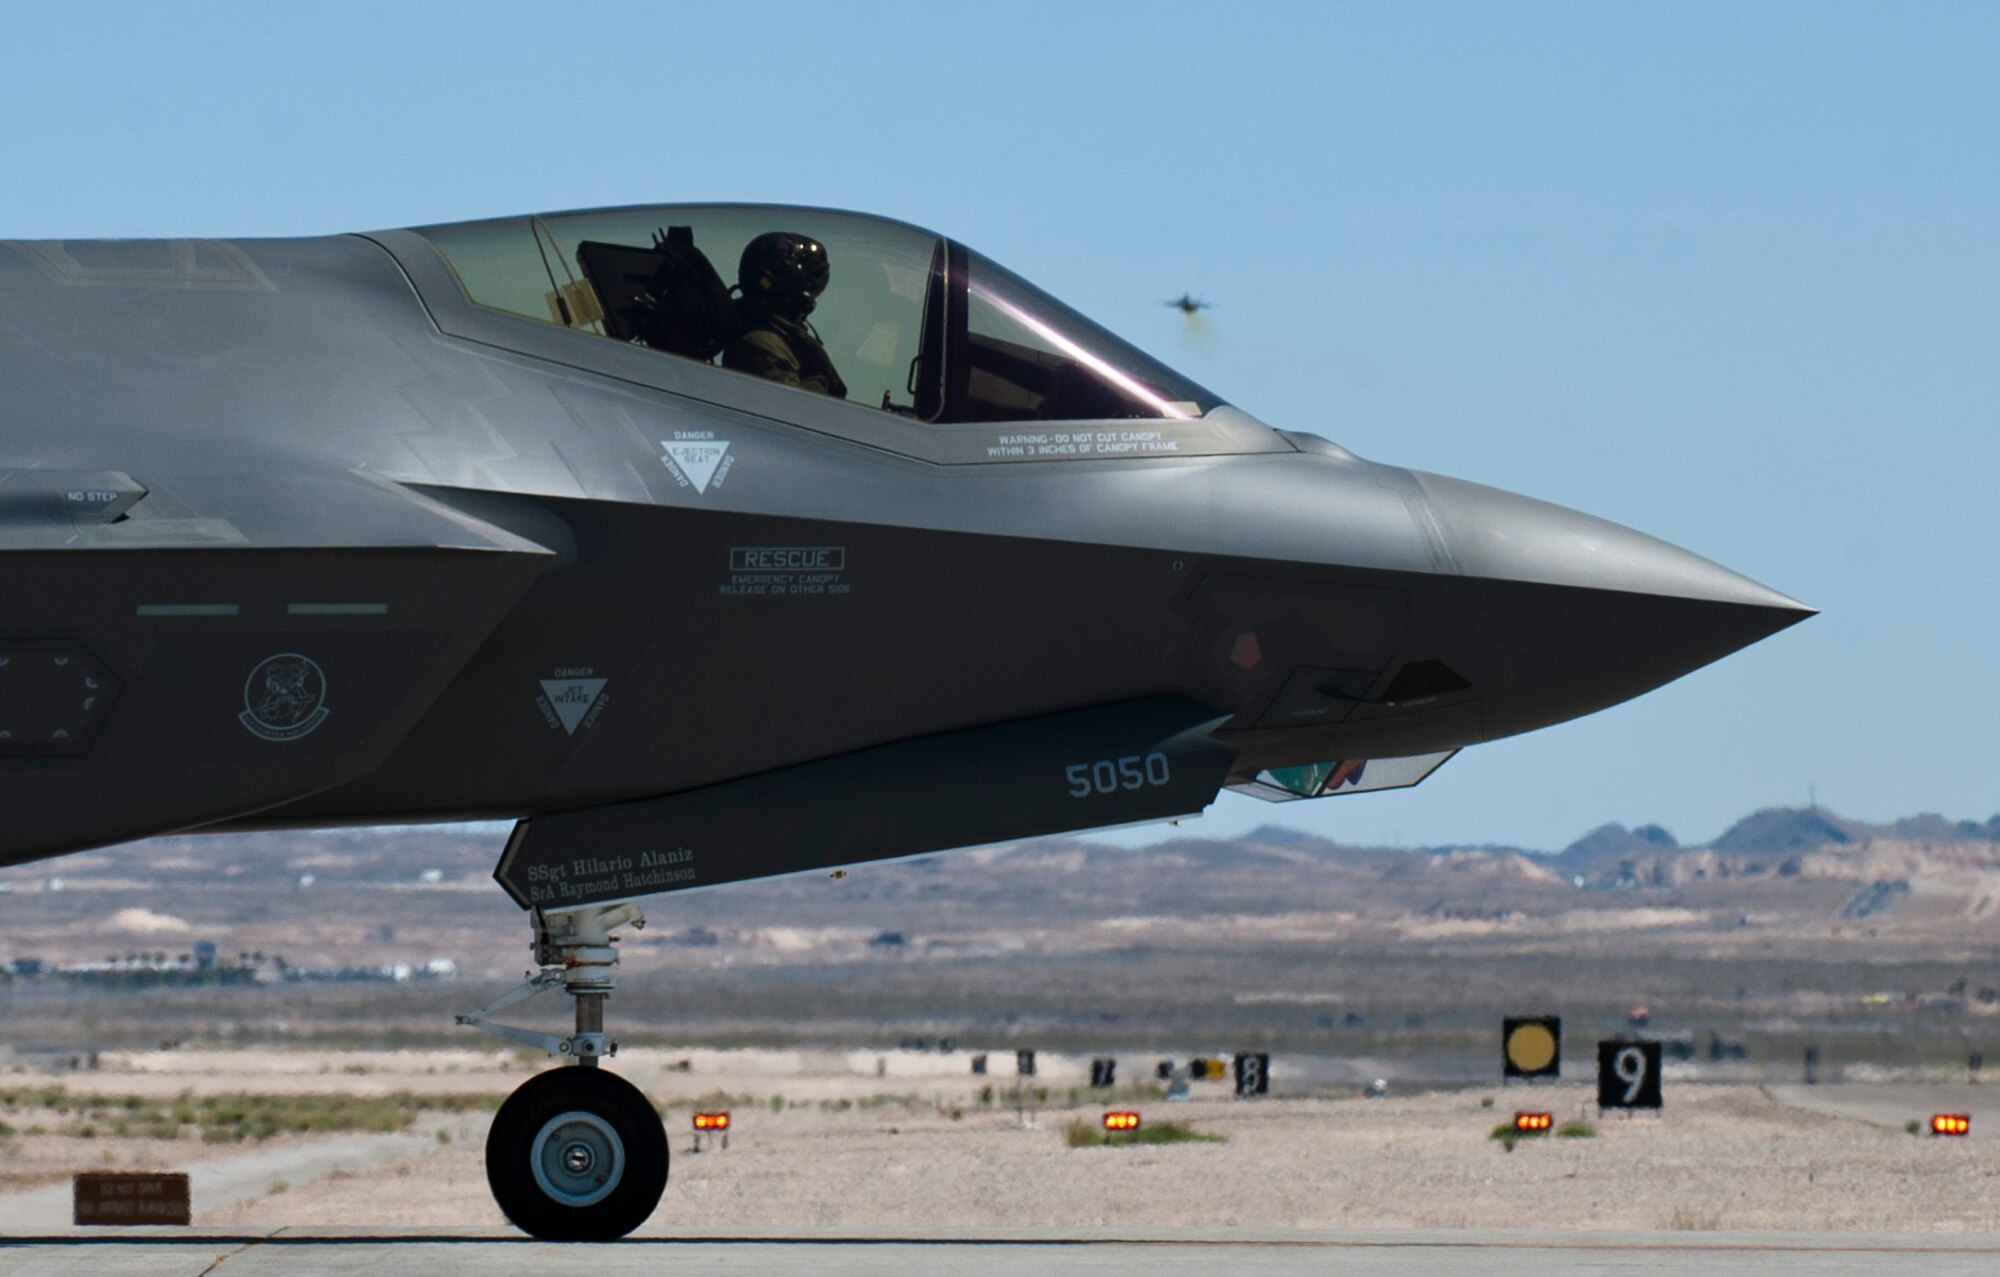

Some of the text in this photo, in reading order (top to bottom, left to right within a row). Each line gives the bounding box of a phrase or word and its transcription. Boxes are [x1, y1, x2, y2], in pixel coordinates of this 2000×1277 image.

[674, 431, 714, 440] DANGER
[999, 435, 1047, 445] WARNING
[1055, 433, 1070, 444] DO
[1072, 433, 1092, 443] NOT
[1097, 433, 1117, 442] CUT
[1121, 432, 1161, 441] CANOPY
[672, 447, 720, 456] EJECTION
[987, 441, 1178, 456] WITHIN 3 INCHES OF CANOPY FRAME
[684, 455, 709, 464] SEAT
[660, 454, 689, 488] DANGER
[67, 492, 118, 502] NO STEP
[745, 551, 831, 568] RESCUE
[731, 574, 841, 584] EMERGENCY CANOPY
[719, 584, 851, 594] RELEASE ON OTHER SIDE
[554, 667, 594, 677] DANGER
[1065, 752, 1170, 798] 5050
[527, 847, 694, 883] SSgt Hilario Alaniz
[530, 868, 696, 900] SrA Raymond Hutchinson
[1614, 1046, 1647, 1103] 9
